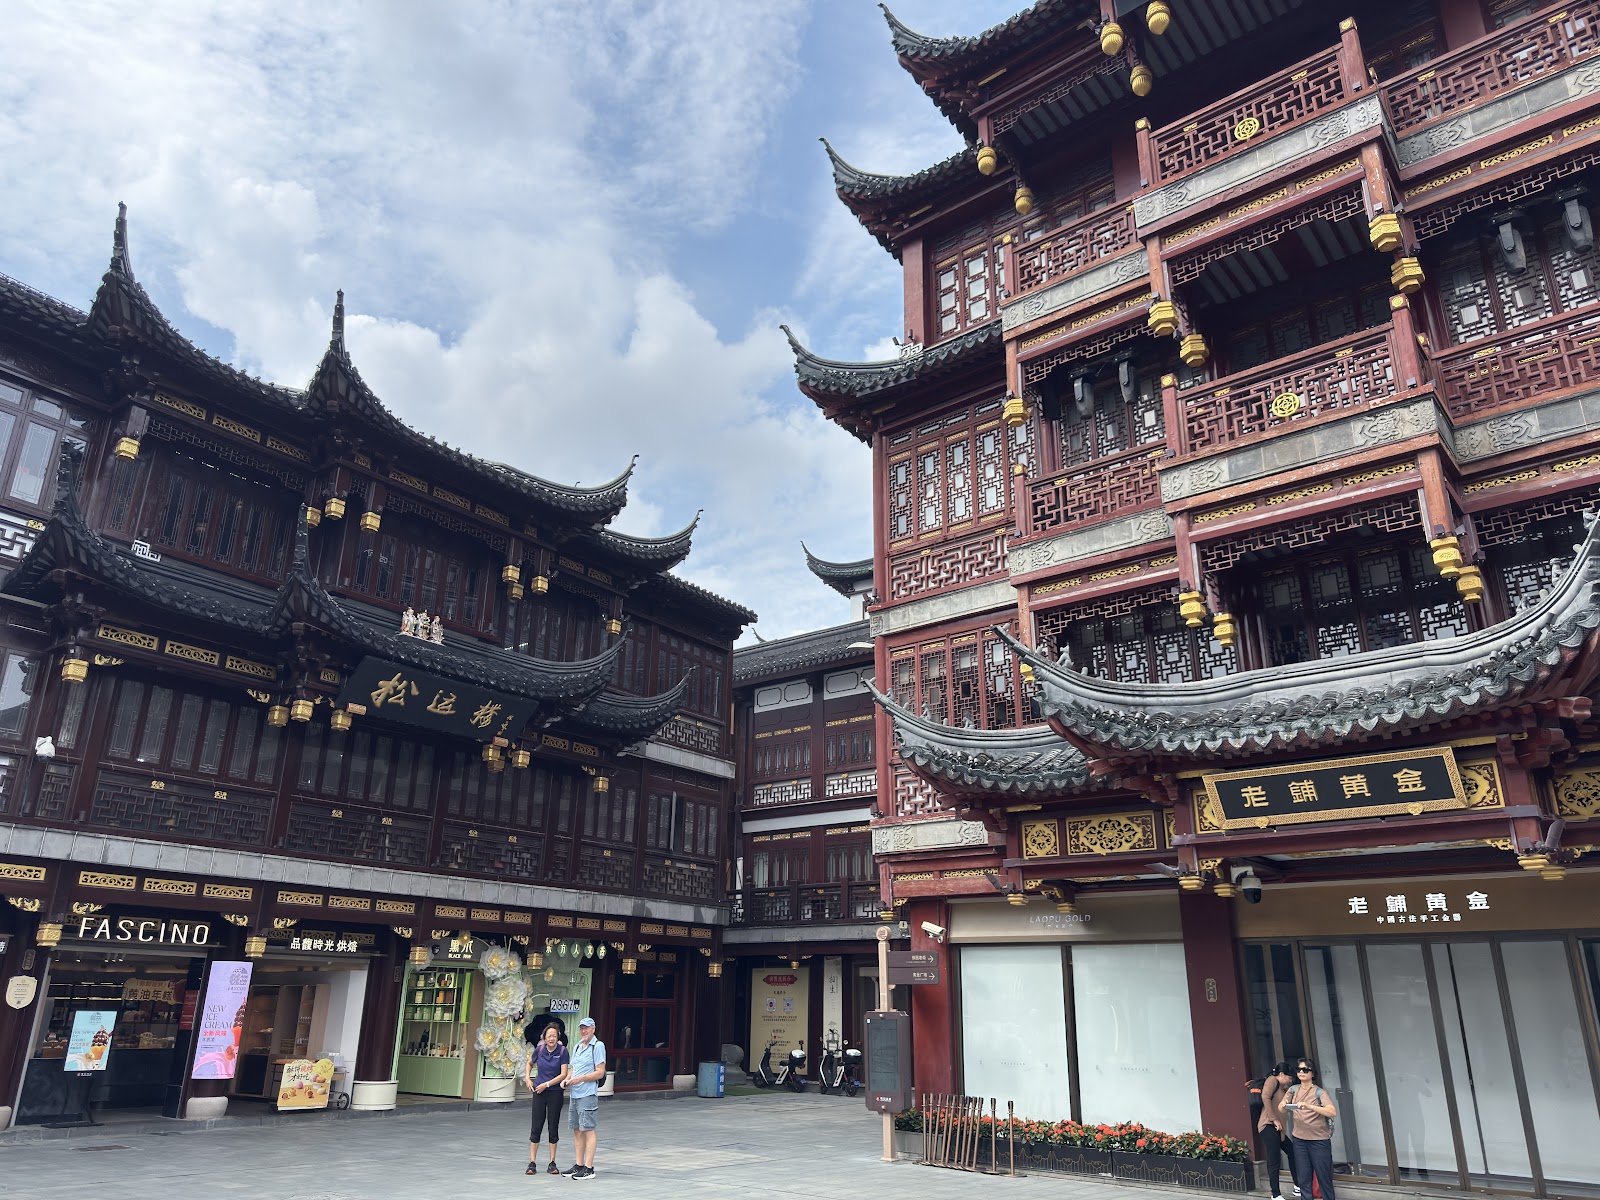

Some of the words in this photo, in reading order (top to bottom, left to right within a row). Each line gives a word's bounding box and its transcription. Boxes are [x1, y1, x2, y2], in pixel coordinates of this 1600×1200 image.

[1029, 915, 1061, 924] LAOPU
[1065, 914, 1092, 922] GOLD
[78, 917, 209, 945] FASCINO
[207, 1004, 227, 1013] NEW
[205, 1012, 219, 1021] ICE
[204, 1021, 233, 1029] CREAM
